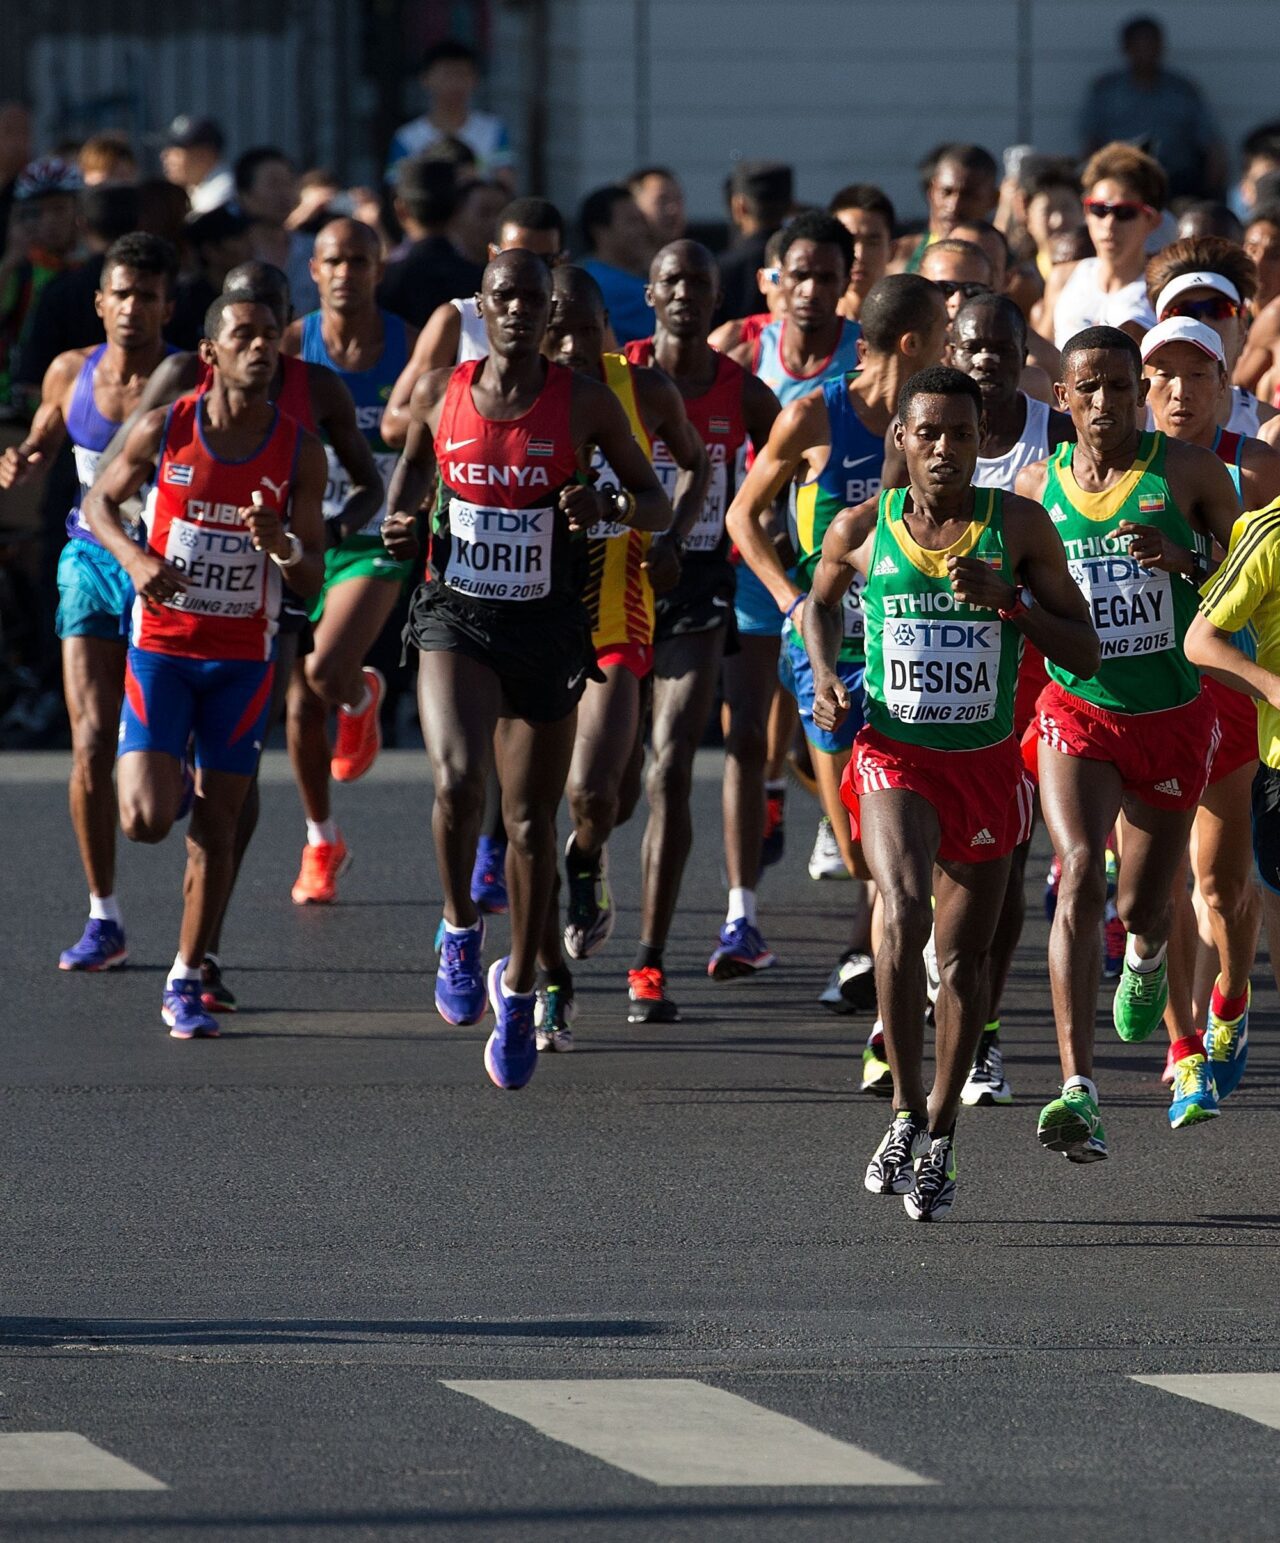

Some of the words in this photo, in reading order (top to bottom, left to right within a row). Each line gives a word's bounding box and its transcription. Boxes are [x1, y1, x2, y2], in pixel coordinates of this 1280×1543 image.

[449, 461, 549, 487] KENYA
[476, 510, 543, 533] TDK
[456, 538, 542, 573] KORIR
[173, 554, 257, 592] PÉREZ
[450, 576, 507, 598] BEIJING
[510, 582, 545, 598] 2015
[915, 624, 992, 649] TDK
[1132, 631, 1170, 652] 2015
[890, 659, 991, 694] DESISA
[892, 703, 953, 721] BEIJING
[954, 703, 991, 721] 2015
[1154, 784, 1182, 797] adidas
[970, 836, 996, 847] adidas
